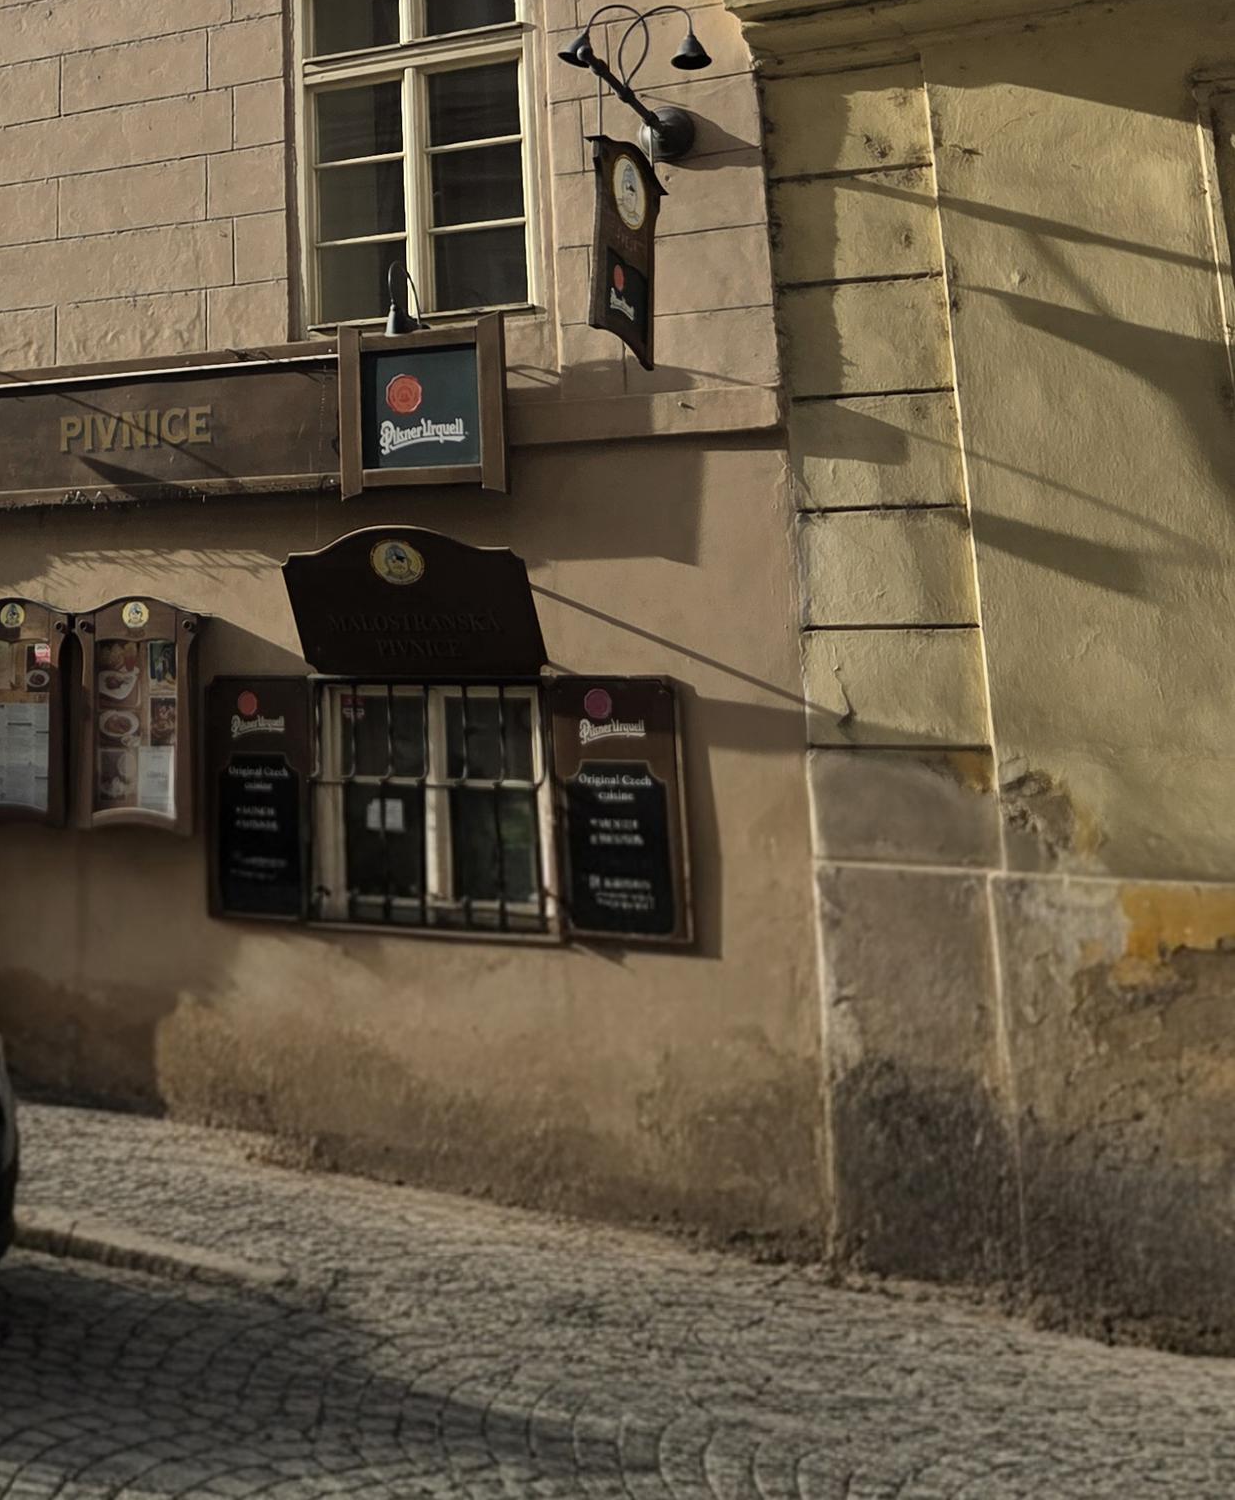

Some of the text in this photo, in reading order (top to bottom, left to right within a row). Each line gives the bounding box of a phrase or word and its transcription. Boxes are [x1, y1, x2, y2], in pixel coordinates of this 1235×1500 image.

[60, 404, 212, 454] PIVNICE
[379, 417, 464, 456] Pilsner Urquell
[328, 608, 503, 632] MALOSTRANSKÁ
[375, 638, 462, 658] PIVNICE
[579, 718, 646, 745] Pilsner Urquell
[578, 773, 652, 788] Original Czech
[598, 790, 635, 802] cuisine
